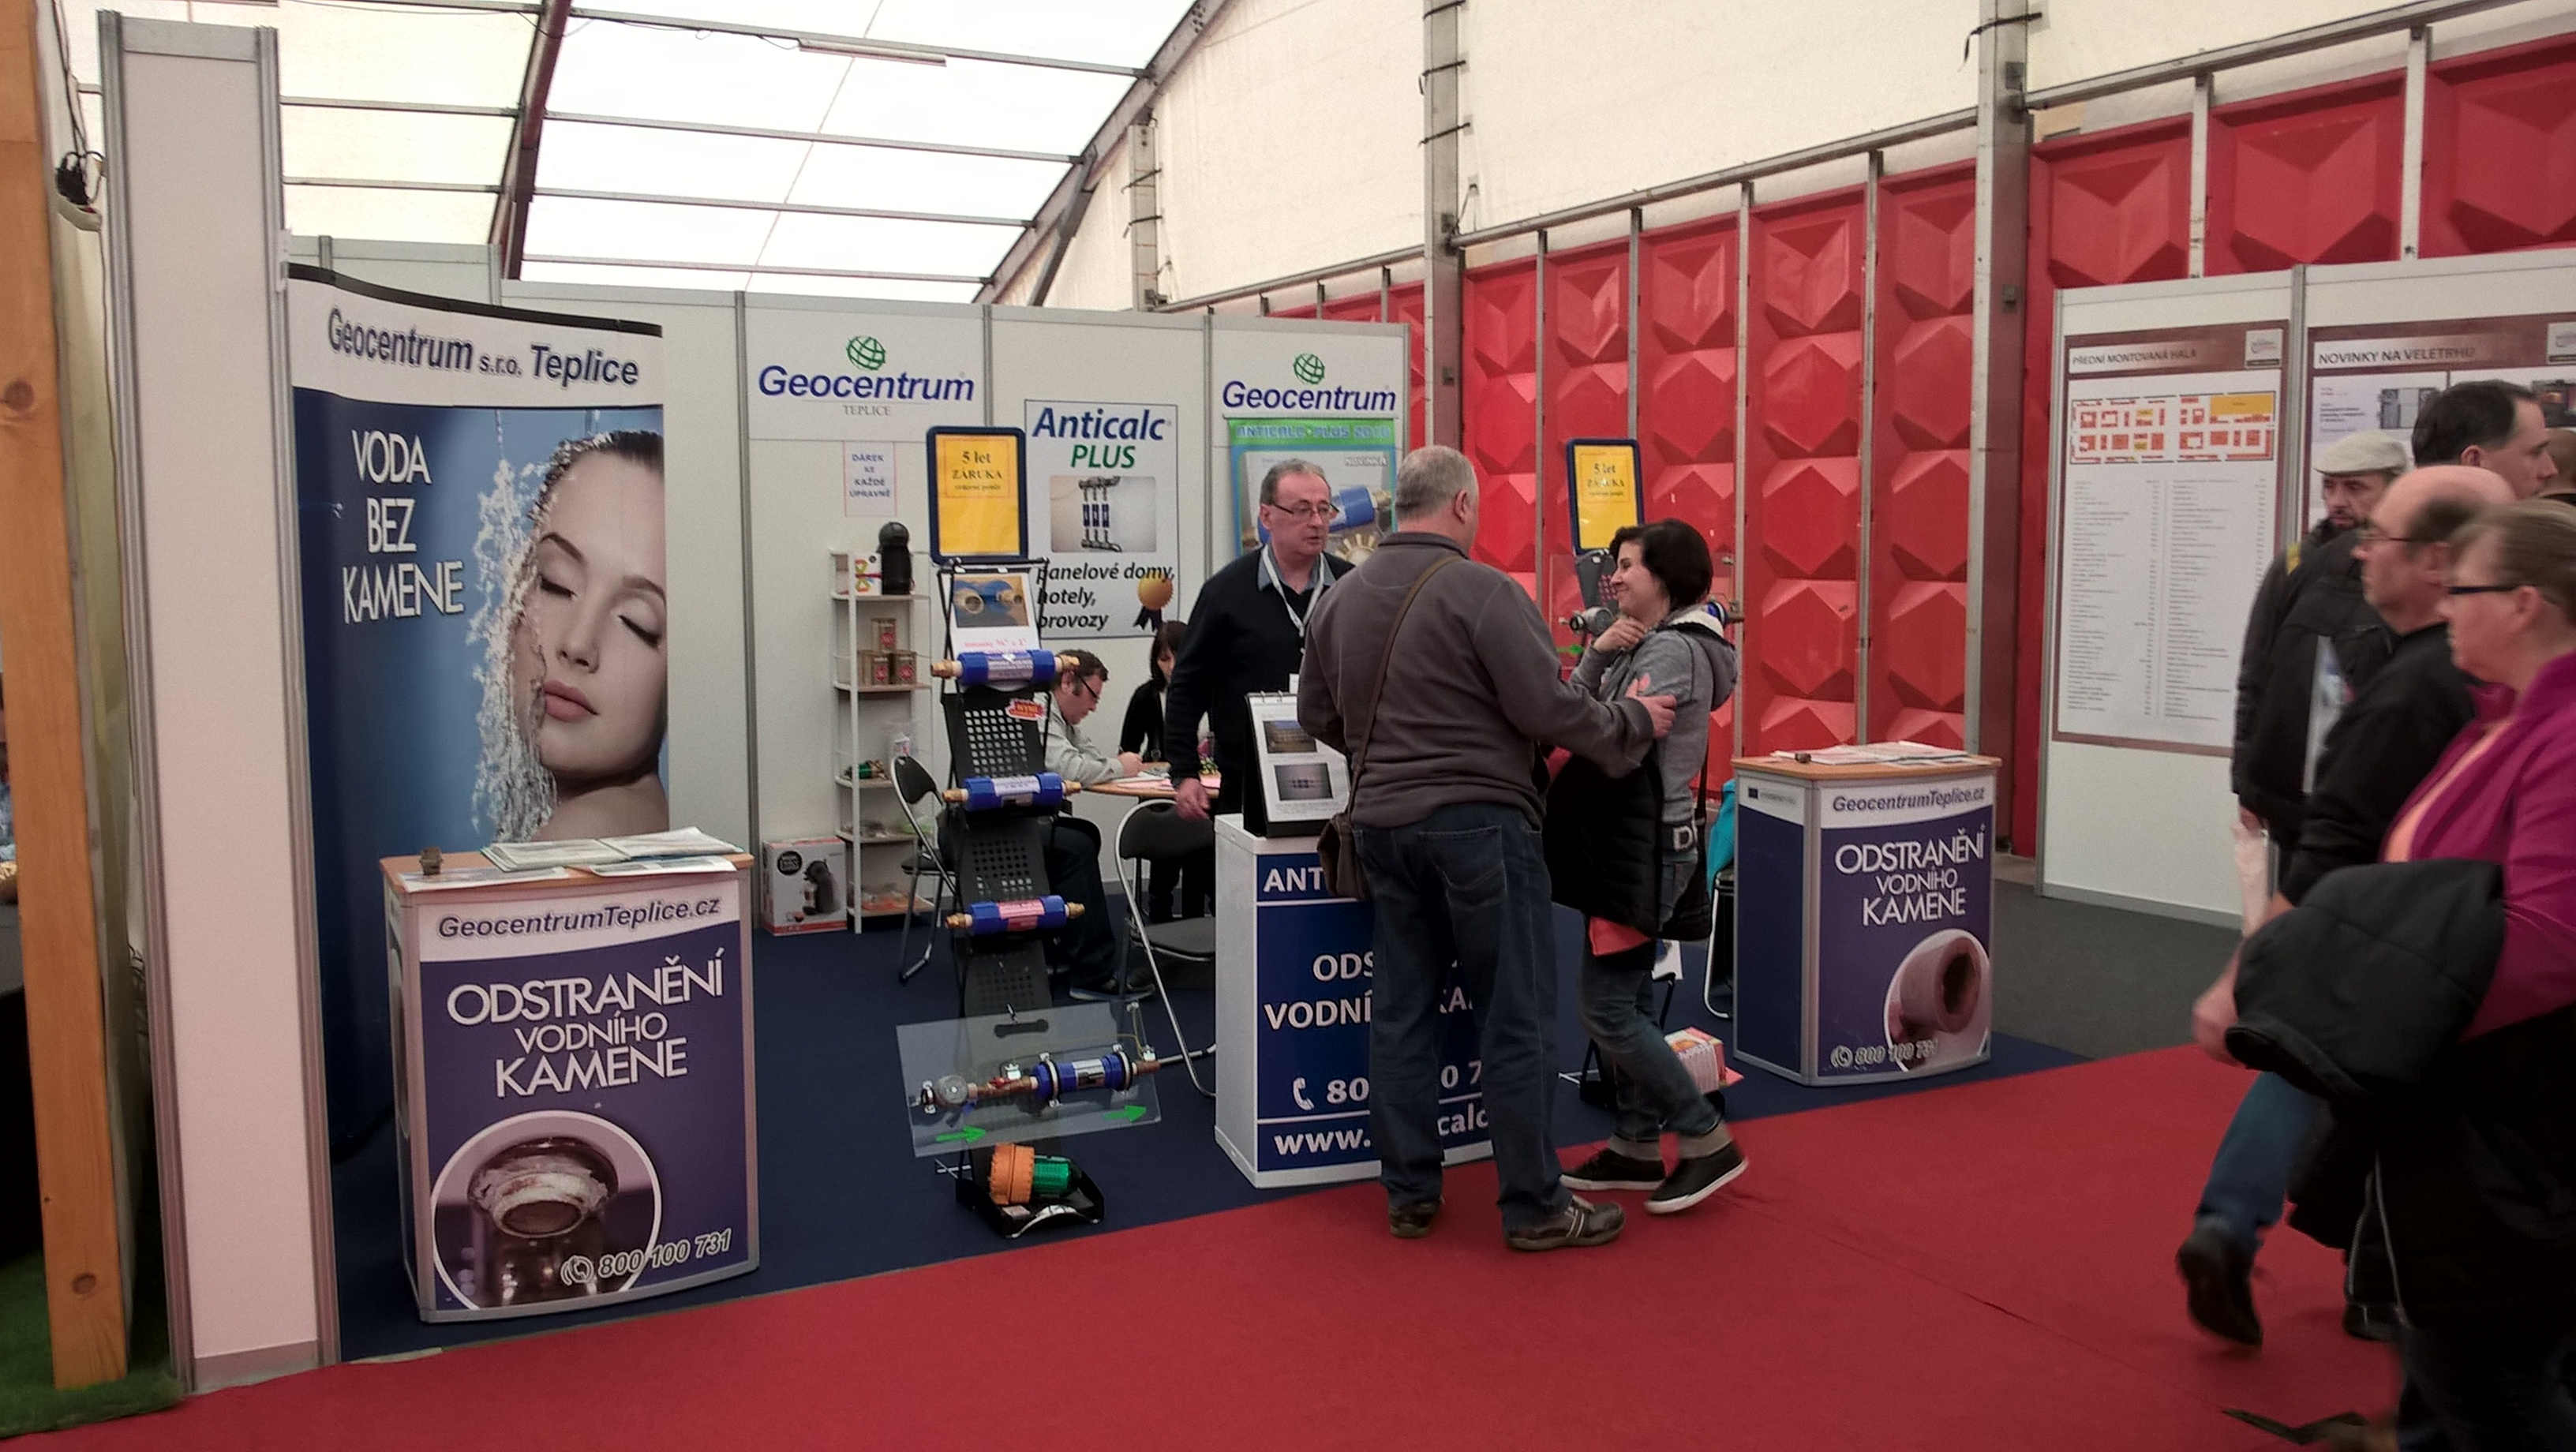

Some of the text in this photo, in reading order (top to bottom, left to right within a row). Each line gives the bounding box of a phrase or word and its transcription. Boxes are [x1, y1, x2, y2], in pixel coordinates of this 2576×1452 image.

[328, 308, 638, 387] Geocentrum s.r.o. Teplice
[2319, 350, 2379, 365] NOVINKY
[2381, 350, 2402, 362] NA
[758, 365, 975, 401] Geocentrum
[1222, 380, 1396, 411] Geocentrum
[843, 405, 892, 416] TEPLICE
[1033, 407, 1166, 440] Anticalc
[352, 429, 432, 484] VODA
[962, 450, 990, 464] 5 let
[1071, 444, 1136, 469] PLUS
[368, 498, 417, 553] BEZ
[1124, 562, 1175, 582] domy,
[343, 561, 464, 623] KAMENE
[1833, 787, 1985, 814] GeocentrumTeplice.cz
[1835, 824, 1986, 874] ODSTRANĚNÍ
[1263, 866, 1325, 893] ANT
[1876, 867, 1959, 896] VODNÍHO
[438, 896, 721, 939] GeocentrumTeplice.cz
[1863, 887, 1967, 926] KAMENE
[447, 948, 724, 1026] ODSTRANĚNÍ
[1264, 989, 1373, 1030] VODNÍ
[515, 1010, 668, 1054] VODNÍHO
[496, 1038, 688, 1098] KAMENE
[1327, 1076, 1370, 1103] 80
[598, 1228, 732, 1279] 800 100 731
